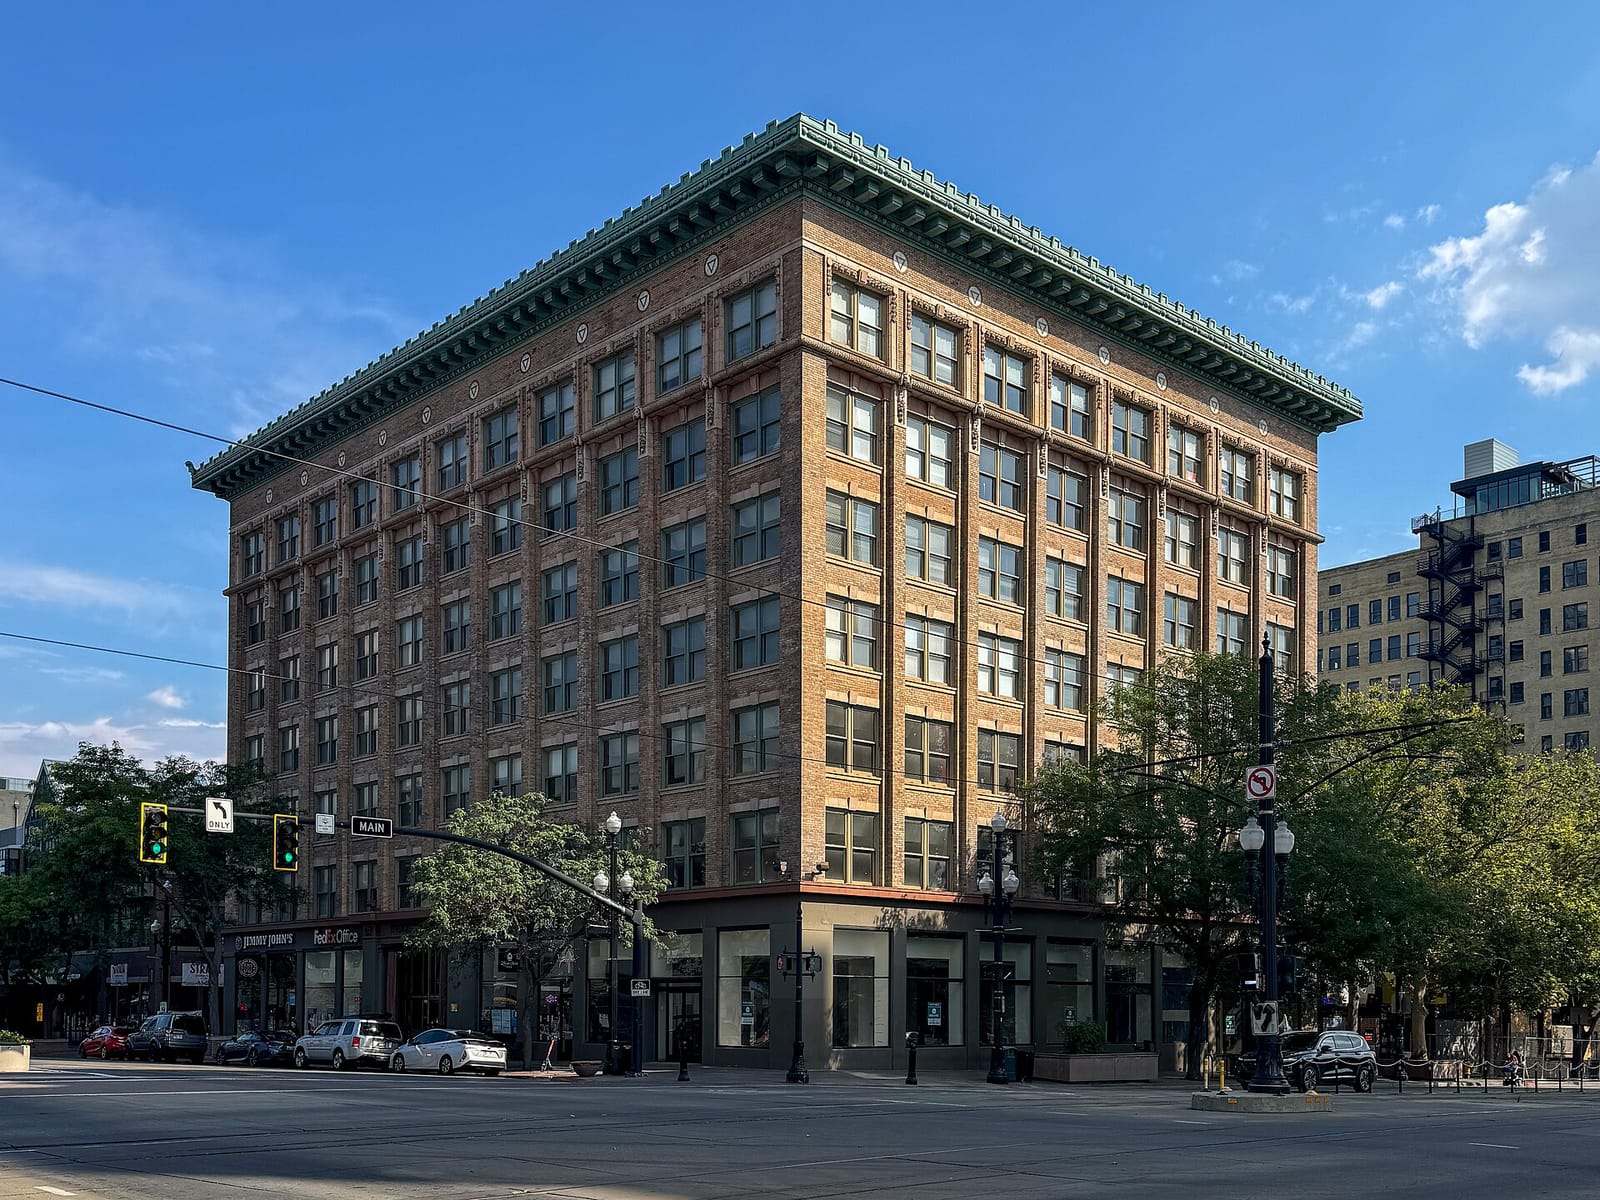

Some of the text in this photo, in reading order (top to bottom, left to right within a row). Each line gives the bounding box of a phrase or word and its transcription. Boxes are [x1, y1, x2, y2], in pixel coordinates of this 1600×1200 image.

[208, 820, 230, 829] ONLY
[359, 821, 385, 833] MAIN
[243, 935, 267, 949] JIMMY
[268, 932, 294, 948] JOHN'S
[313, 928, 359, 945] FedEx Office
